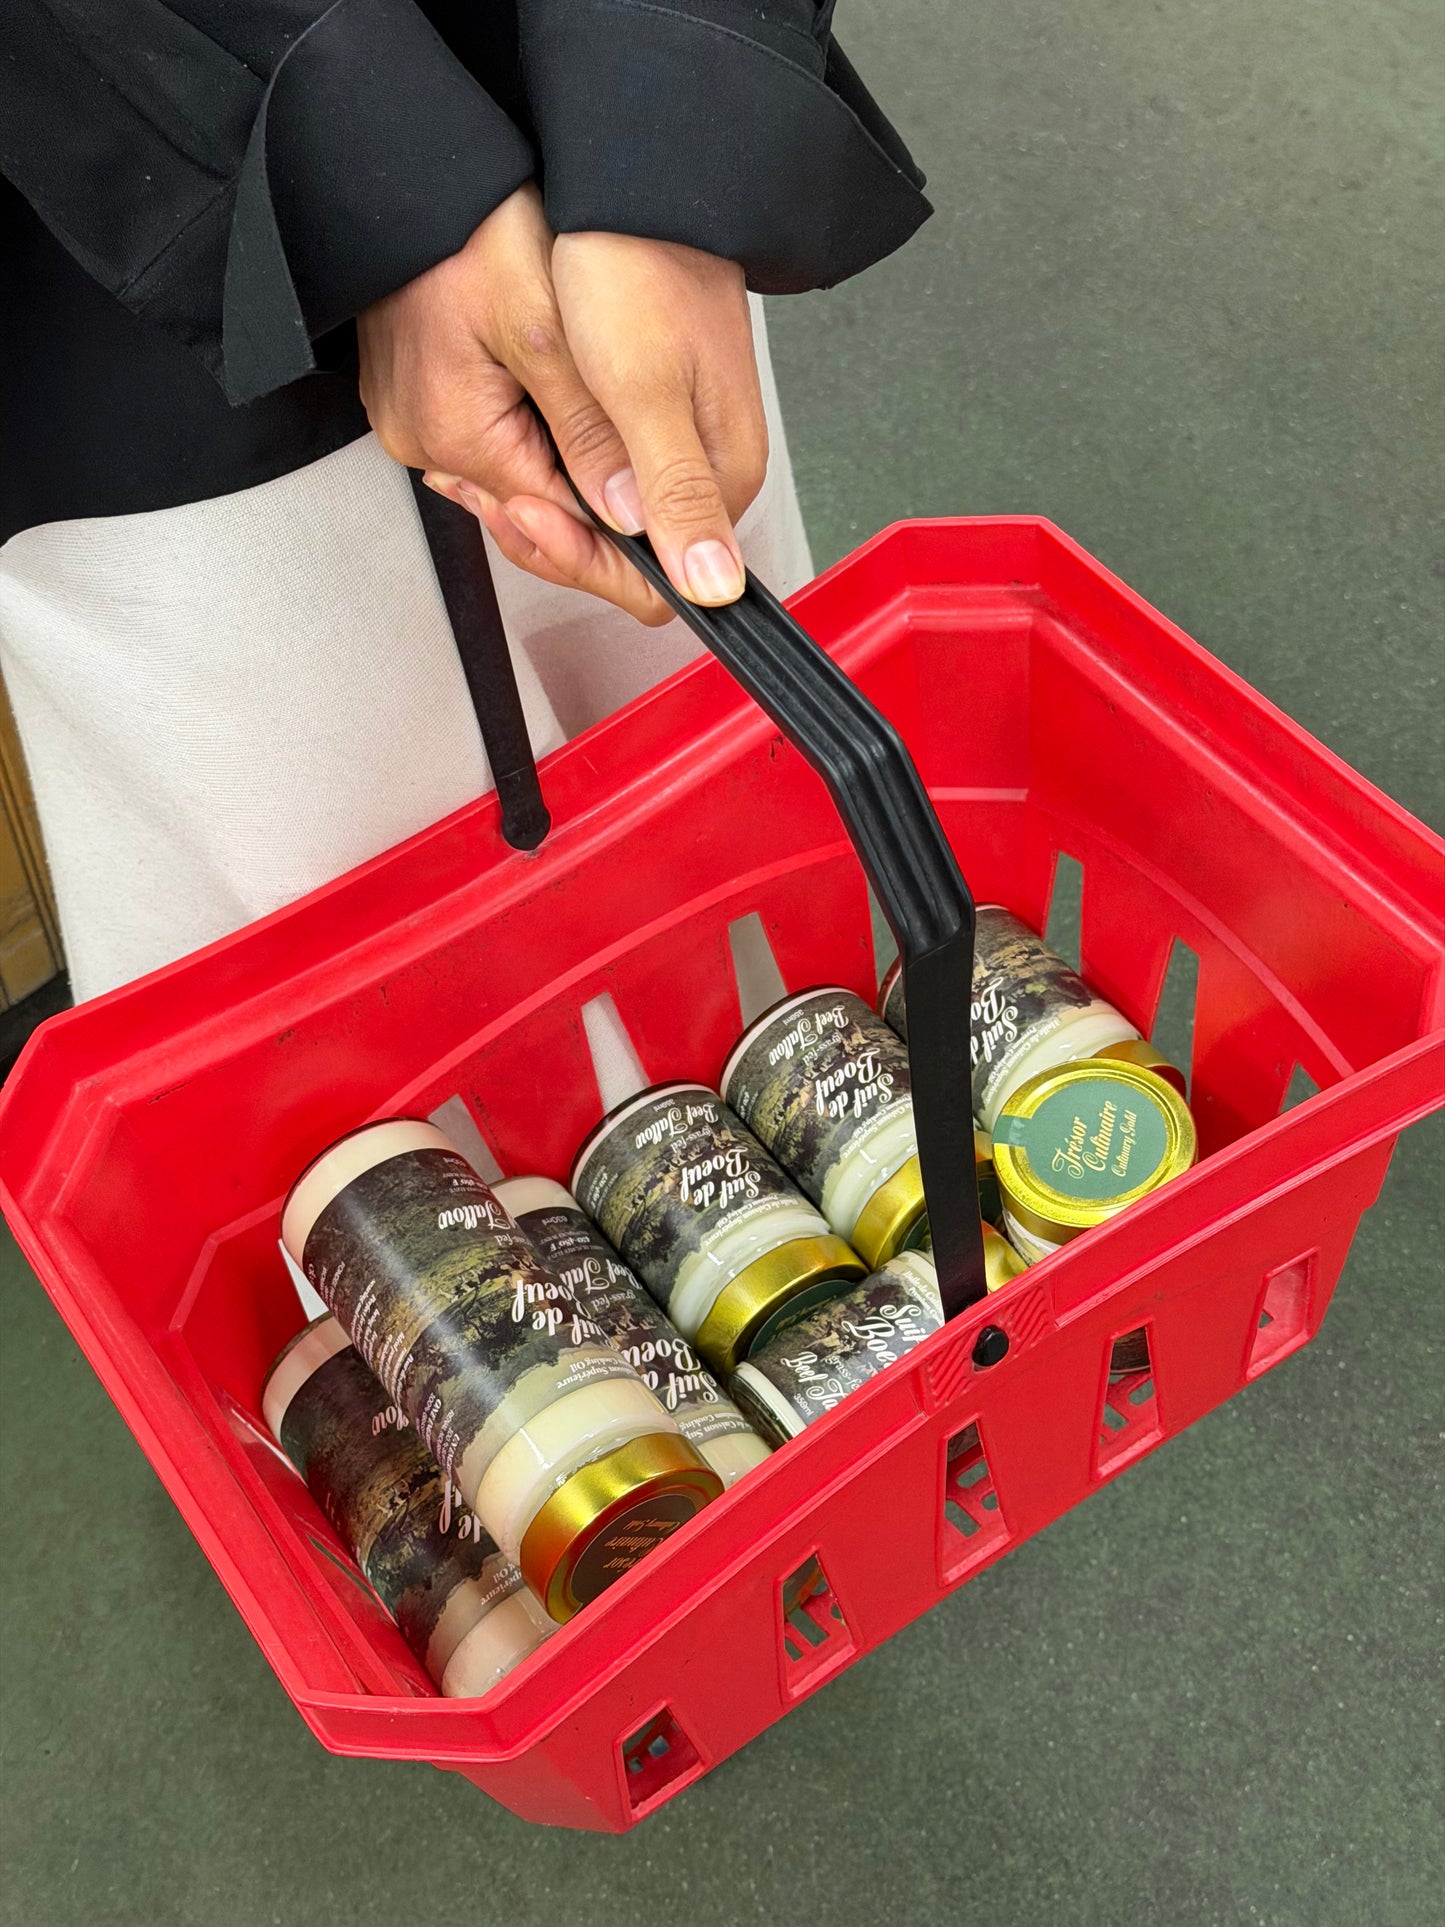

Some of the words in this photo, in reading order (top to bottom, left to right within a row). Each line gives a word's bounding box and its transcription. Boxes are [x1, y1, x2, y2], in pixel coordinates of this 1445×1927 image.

[815, 1005, 849, 1035] Beef
[982, 1006, 1018, 1063] Suif
[768, 1019, 818, 1066] Tallow
[815, 1048, 882, 1116] Boeuf
[853, 1073, 894, 1119] Suif
[686, 1103, 718, 1125] Beef
[829, 1091, 849, 1119] de
[635, 1108, 688, 1149] Tallow
[1082, 1101, 1117, 1171] Culinaire
[1120, 1109, 1137, 1136] Gold
[1052, 1116, 1087, 1179] Trésor
[1111, 1135, 1137, 1177] Culinary
[680, 1146, 749, 1202] Boeuf
[719, 1171, 760, 1209] Suif
[694, 1182, 715, 1207] de
[438, 1200, 511, 1230] Tallow
[532, 1307, 563, 1337] de
[570, 1362, 586, 1373] Oil
[621, 1338, 701, 1372] Boeu
[781, 1351, 828, 1383] Beef
[666, 1370, 718, 1410] Suif
[793, 1392, 815, 1416] 359ml
[430, 1398, 442, 1421] ONE
